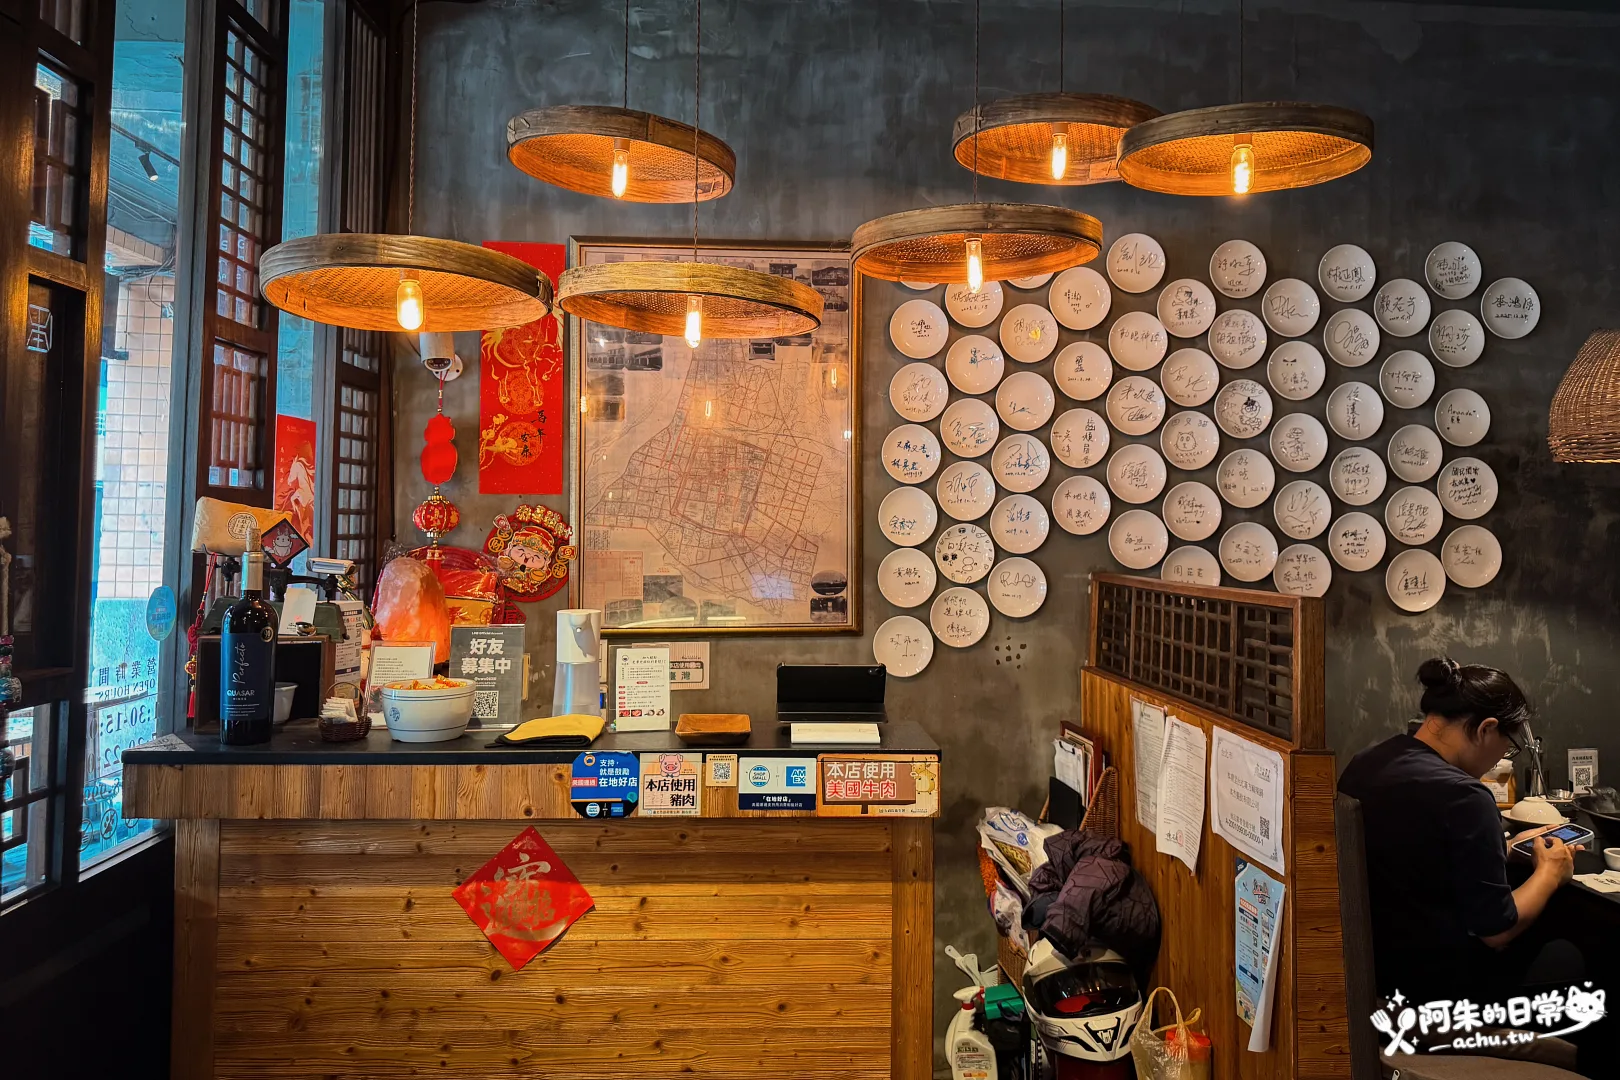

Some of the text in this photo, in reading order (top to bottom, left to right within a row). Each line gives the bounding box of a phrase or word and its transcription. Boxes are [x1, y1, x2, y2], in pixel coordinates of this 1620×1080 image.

[469, 637, 505, 655] 好友
[461, 657, 511, 674] 募集中
[226, 689, 255, 697] QUASAR
[600, 768, 630, 776] 就是鼓勵
[791, 768, 806, 777] AM
[827, 762, 896, 780] 本店使用
[599, 777, 638, 788] 在地好店
[646, 778, 695, 792] 本店使用
[826, 780, 897, 800] 美國牛肉
[670, 794, 695, 806] 豬肉
